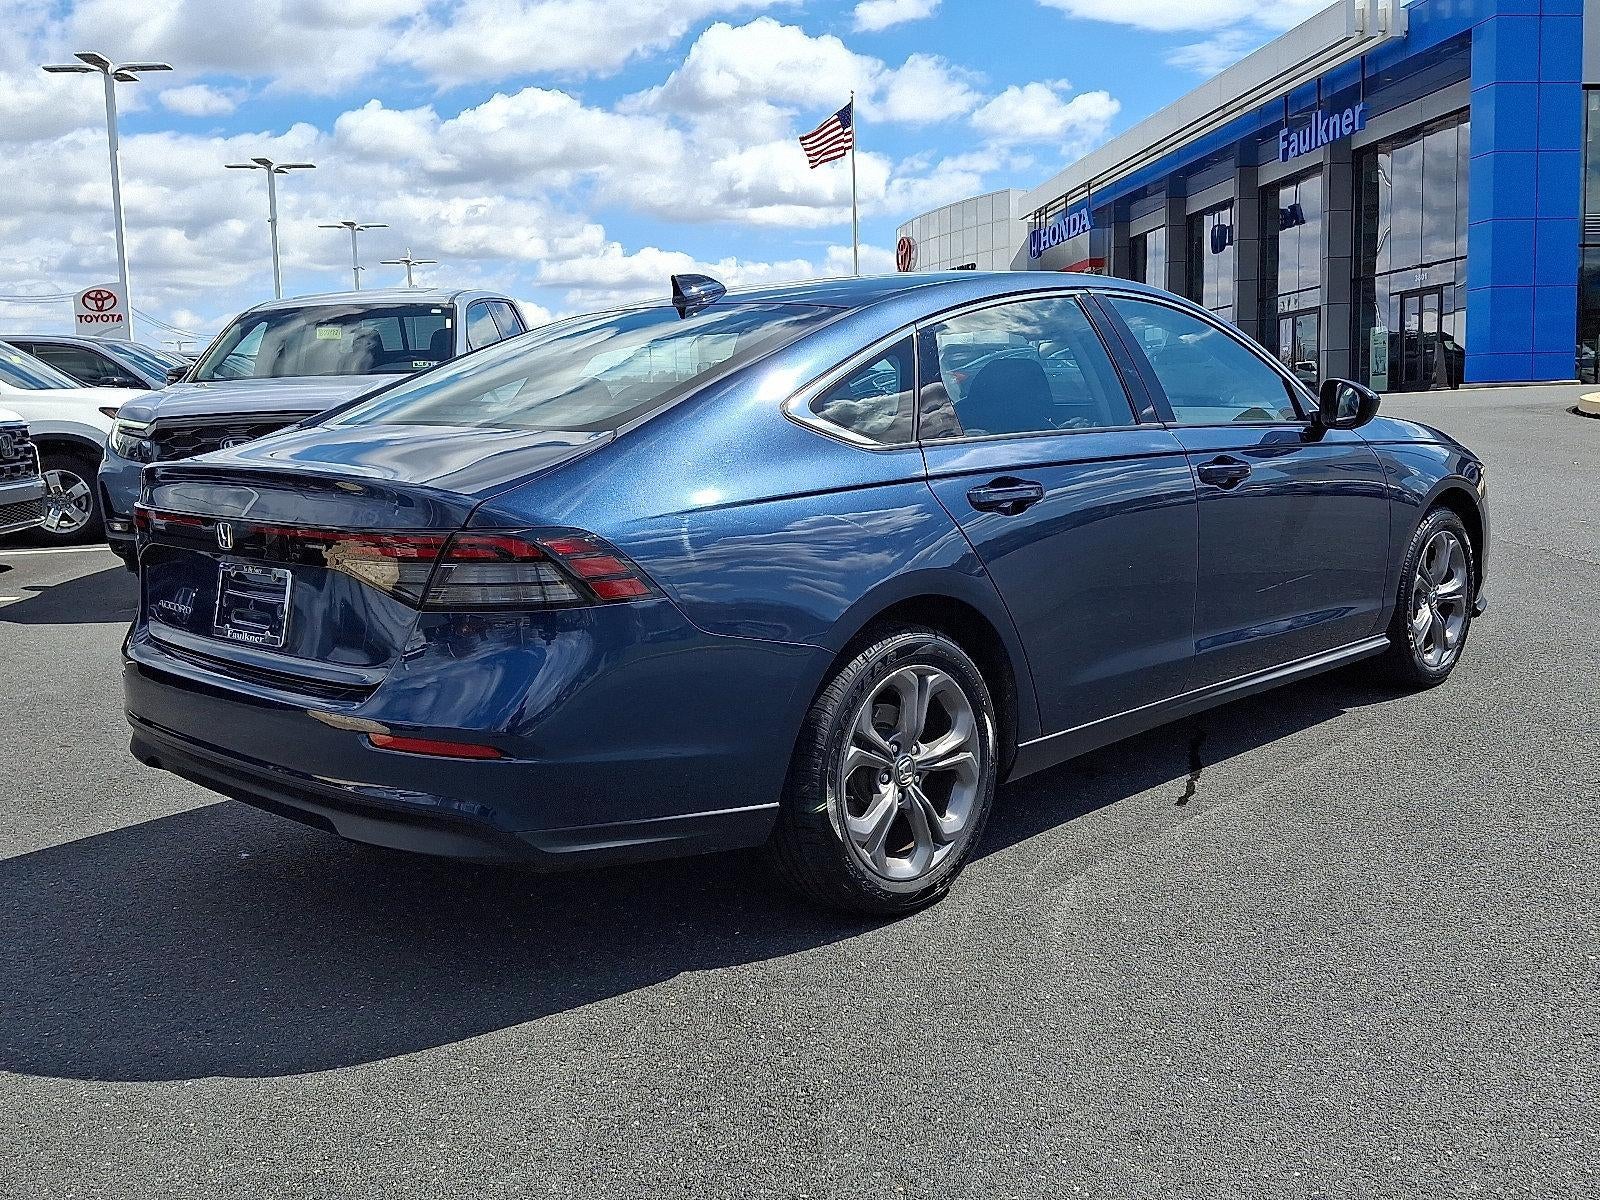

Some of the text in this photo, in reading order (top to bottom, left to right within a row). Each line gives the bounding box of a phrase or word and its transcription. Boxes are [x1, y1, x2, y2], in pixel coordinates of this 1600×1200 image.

[1279, 102, 1364, 162] Faulkner
[1040, 208, 1091, 251] HONDA
[77, 313, 123, 324] TOYOTA
[159, 600, 191, 615] ACCORD
[228, 629, 265, 643] Faulkner
